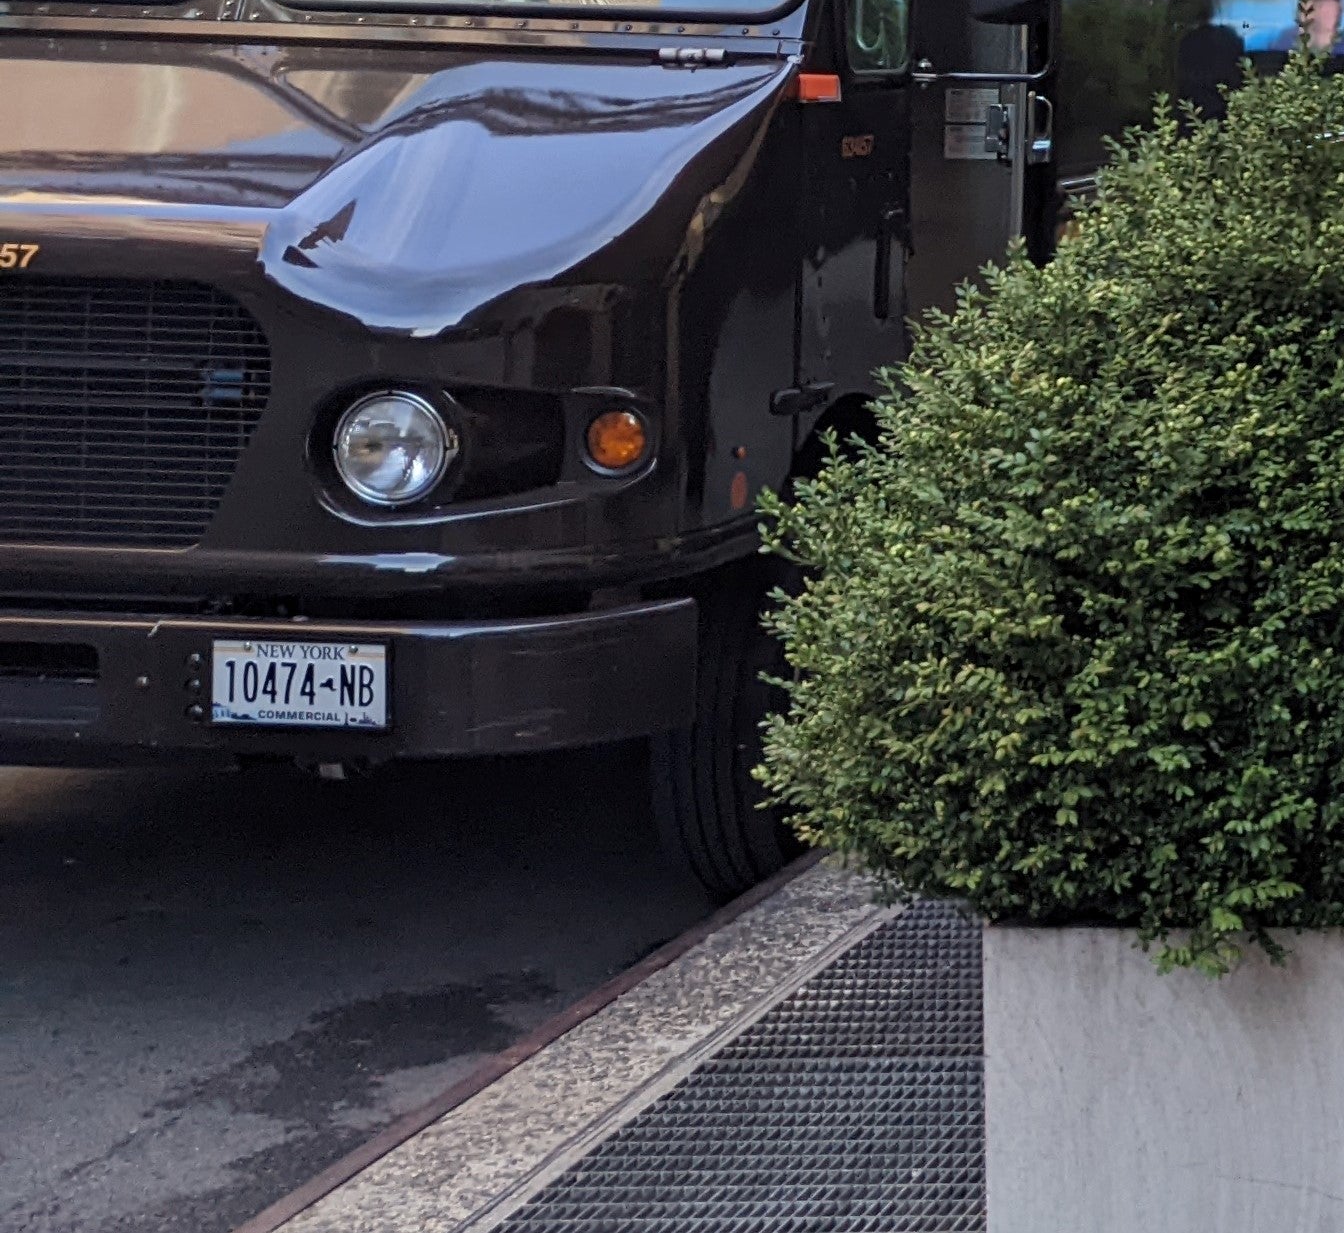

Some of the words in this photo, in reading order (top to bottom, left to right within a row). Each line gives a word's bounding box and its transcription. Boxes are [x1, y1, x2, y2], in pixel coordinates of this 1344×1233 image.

[0, 243, 39, 268] 57
[256, 643, 296, 659] NEW
[299, 644, 347, 661] YORK
[257, 709, 341, 723] COMMERCIAL
